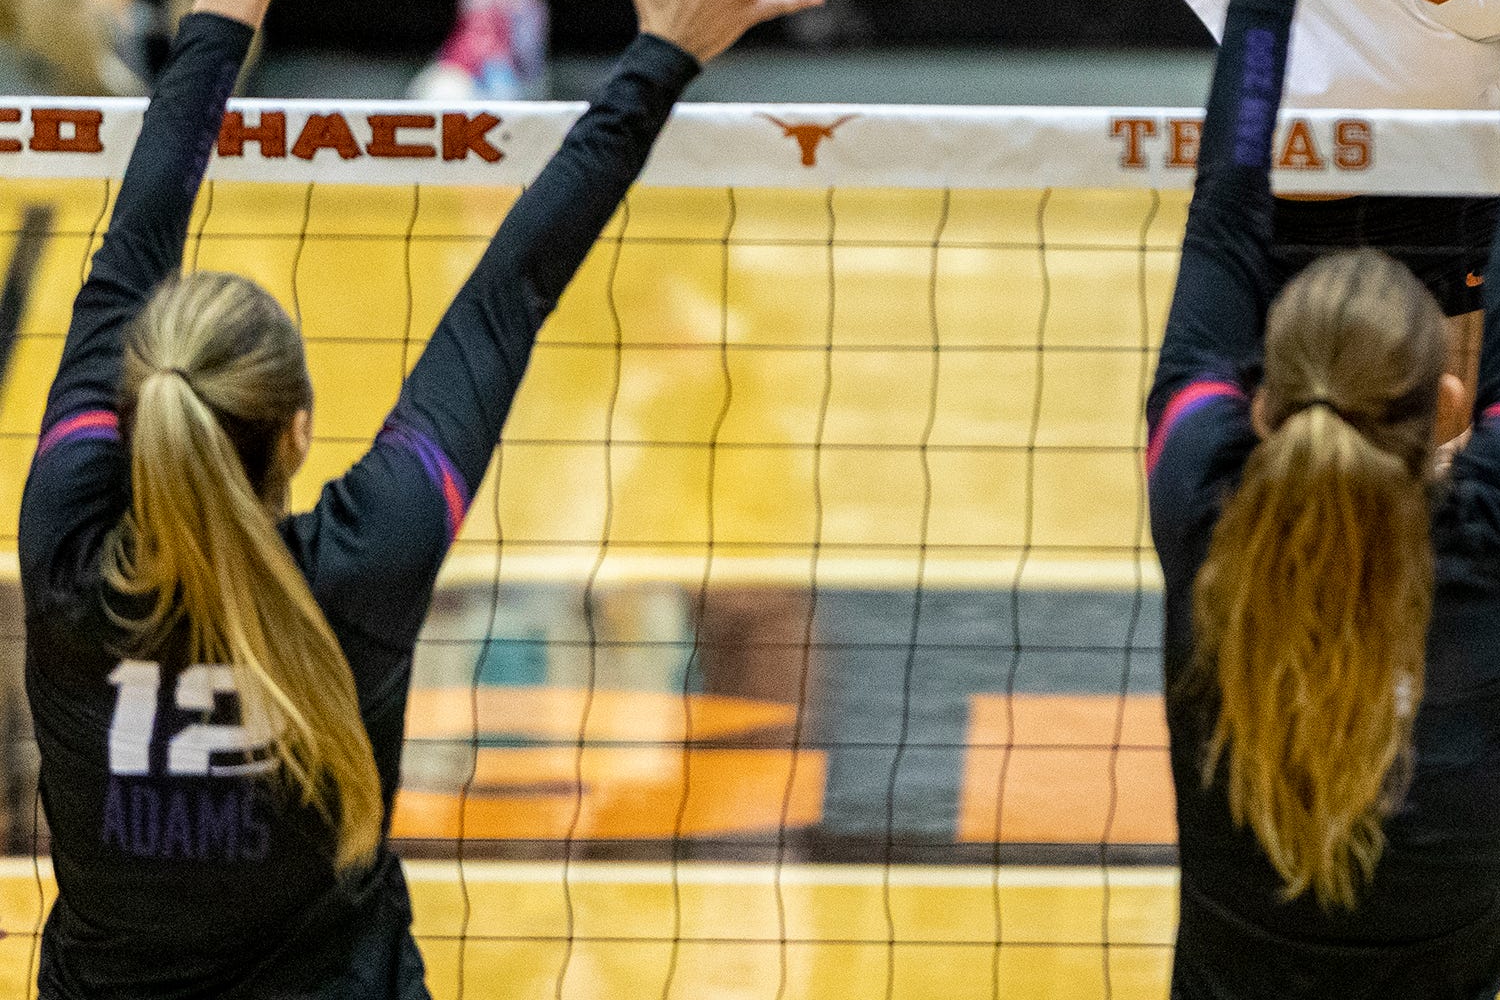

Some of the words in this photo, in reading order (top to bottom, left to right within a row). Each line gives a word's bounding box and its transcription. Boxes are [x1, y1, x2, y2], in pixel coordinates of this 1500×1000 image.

[217, 110, 505, 163] HACK
[1110, 115, 1374, 172] TEAS
[107, 658, 287, 776] 12
[101, 777, 273, 862] ADAMS
